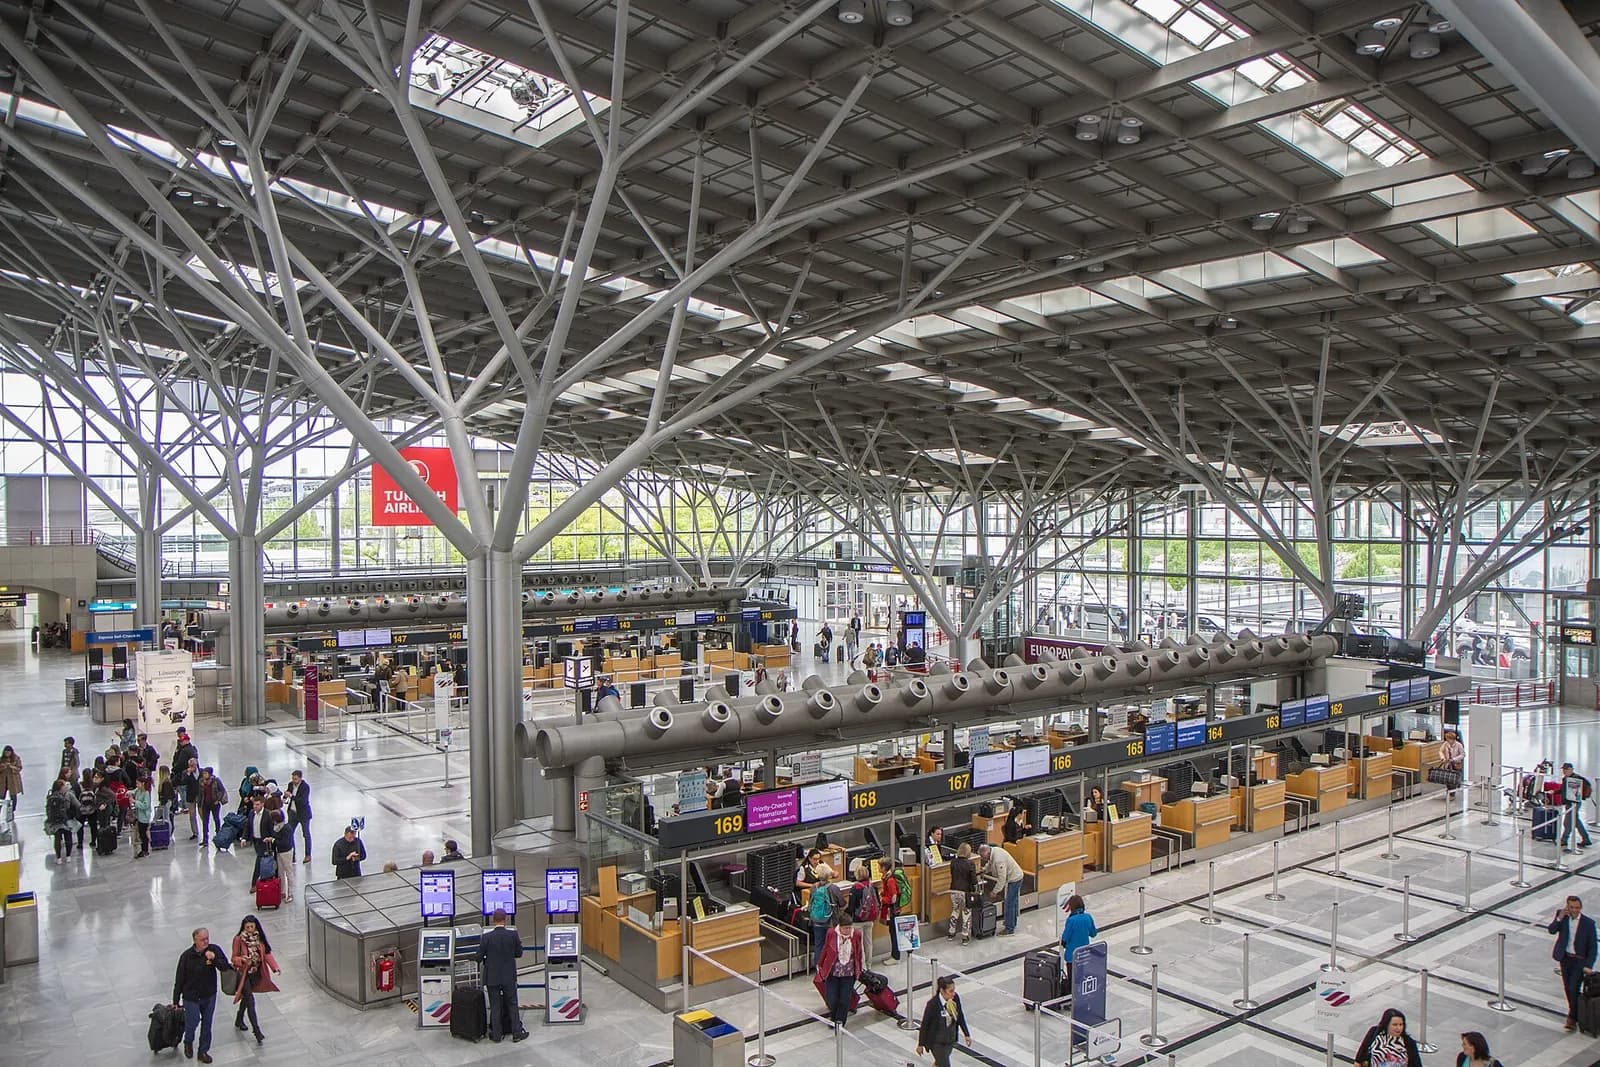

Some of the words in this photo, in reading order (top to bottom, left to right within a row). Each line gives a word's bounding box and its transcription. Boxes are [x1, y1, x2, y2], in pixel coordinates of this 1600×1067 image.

[384, 502, 423, 513] AIRLI
[562, 624, 574, 633] 144
[619, 621, 631, 630] 143
[322, 639, 337, 648] 148
[393, 635, 407, 644] 147
[1431, 684, 1441, 696] 160
[1330, 703, 1343, 716] 162
[1265, 715, 1280, 729] 163
[1207, 726, 1223, 741] 164
[1126, 740, 1143, 757] 165
[1053, 754, 1072, 771] 166
[948, 773, 970, 792] 167
[852, 790, 877, 809] 168
[714, 815, 743, 835] 169
